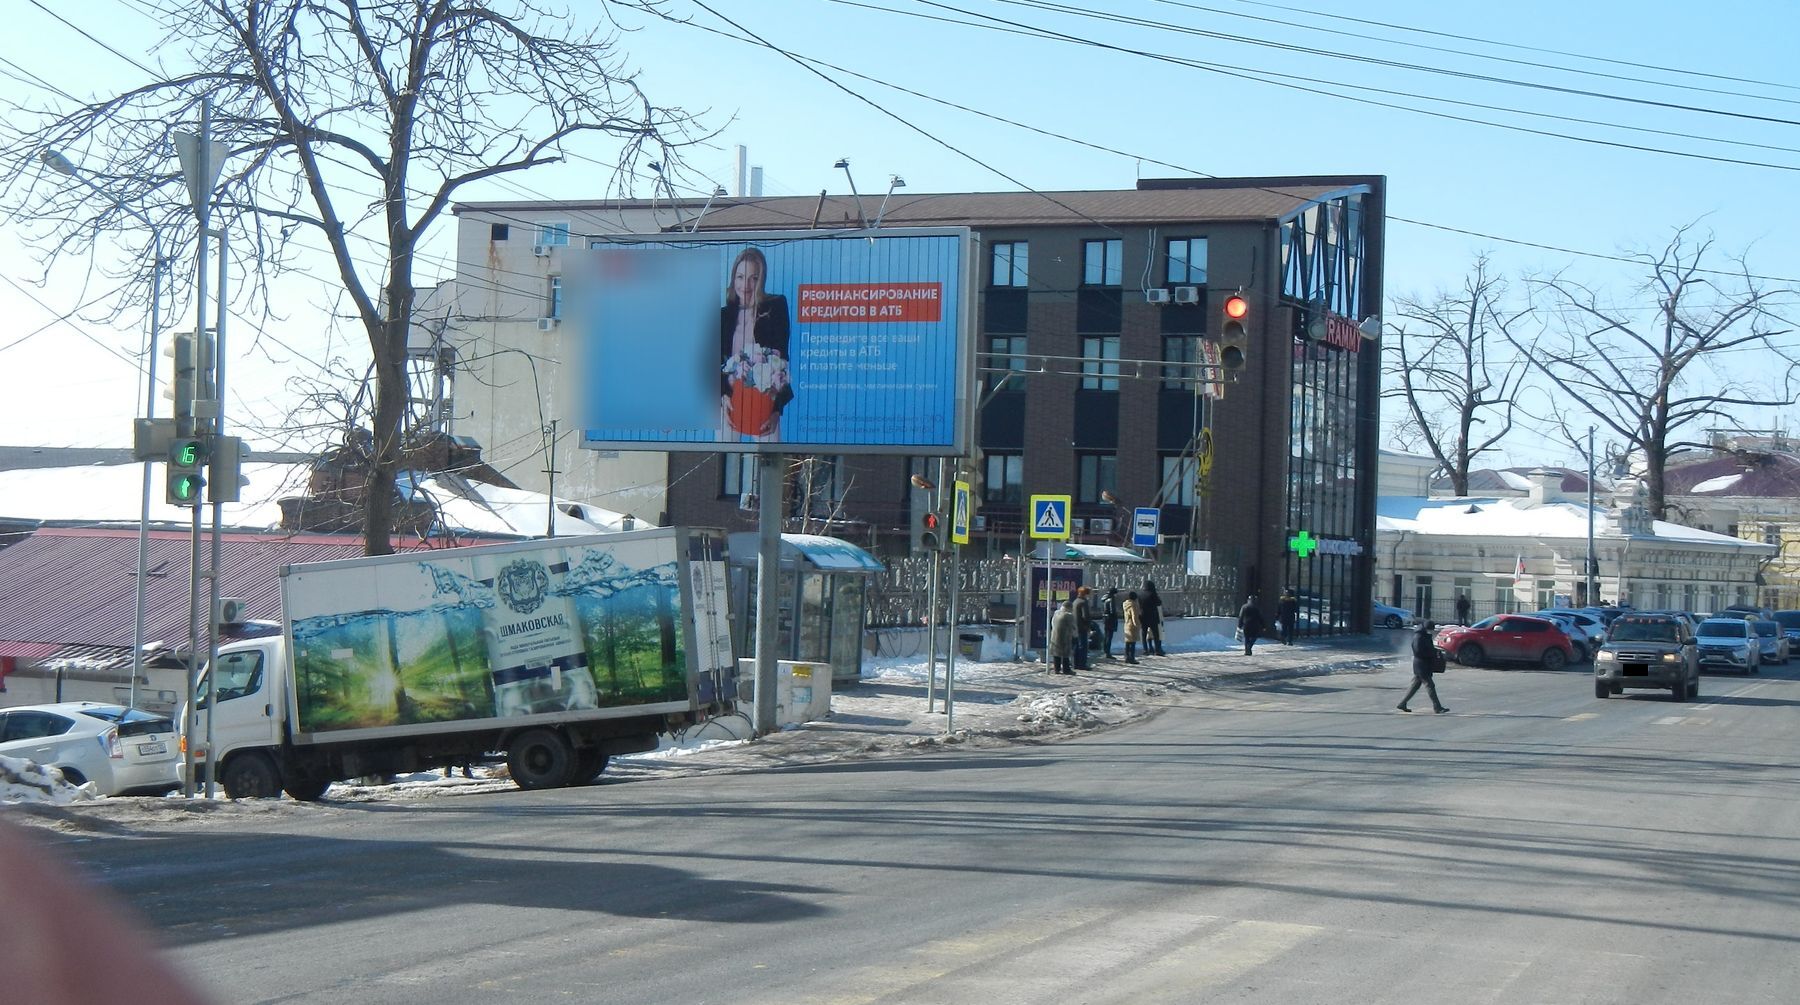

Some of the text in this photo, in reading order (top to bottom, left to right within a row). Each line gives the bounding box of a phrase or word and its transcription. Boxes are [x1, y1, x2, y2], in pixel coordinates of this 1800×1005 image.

[802, 288, 938, 301] РЕФИНАНСИРОВАНИЕ
[801, 304, 902, 318] КРЕДИТОВ В АТБ
[801, 331, 868, 345] Переведите
[800, 347, 847, 359] кредиты
[859, 345, 881, 357] АТБ
[800, 362, 807, 371] и
[182, 446, 195, 464] 16
[500, 613, 565, 637] ШМАКОВСКАЯ
